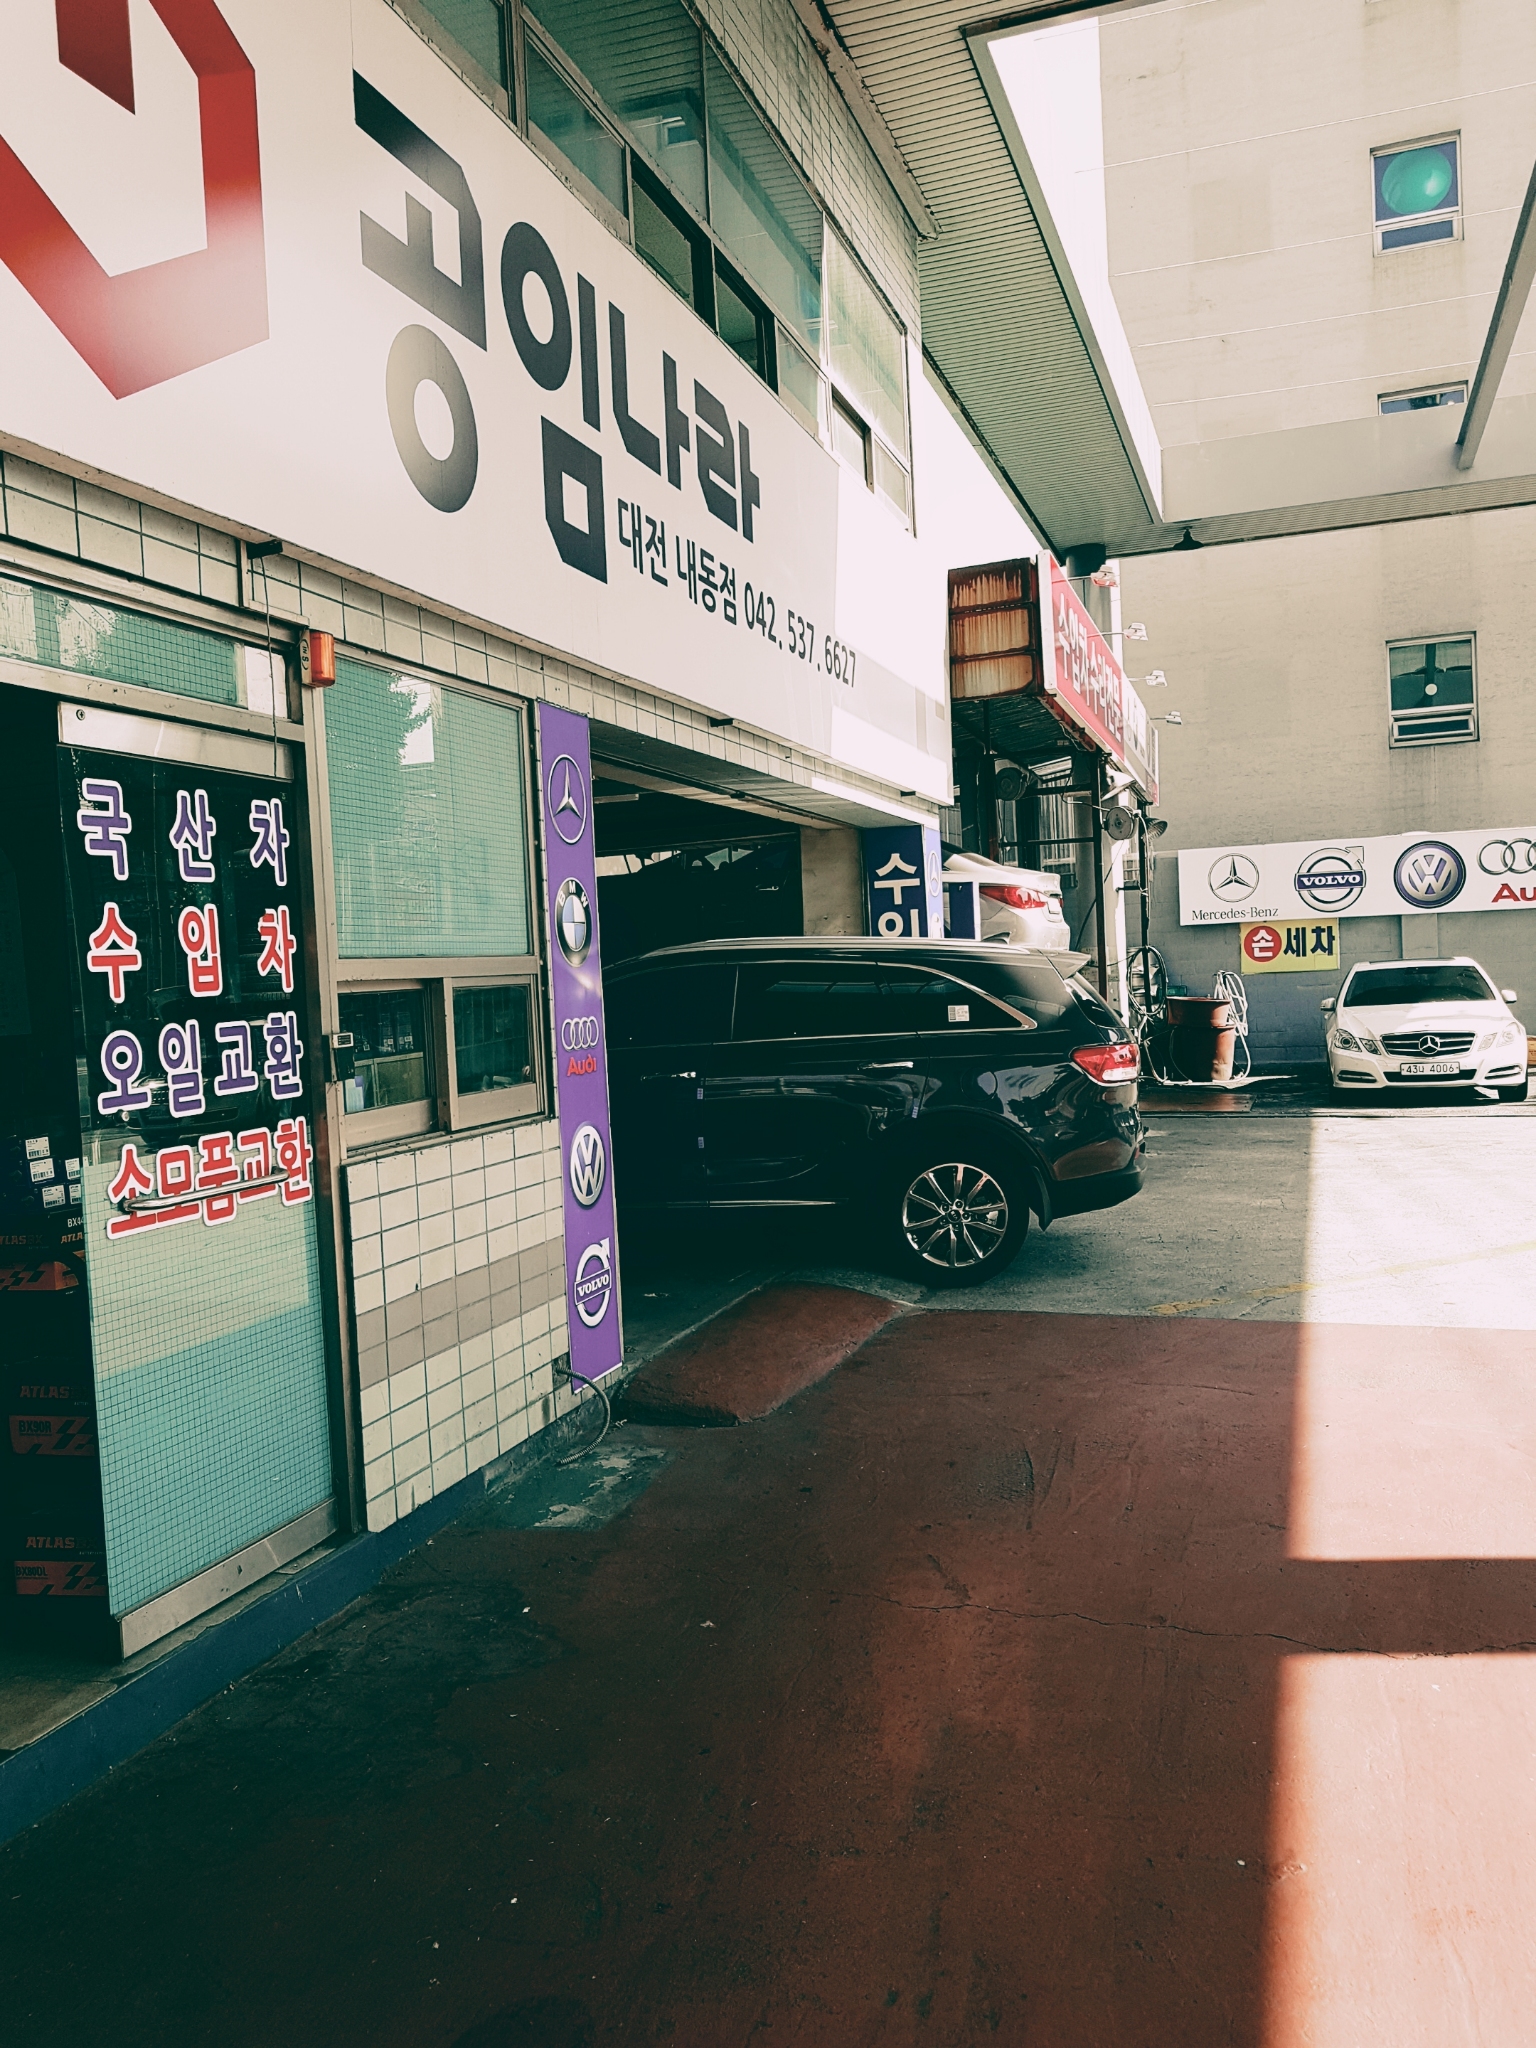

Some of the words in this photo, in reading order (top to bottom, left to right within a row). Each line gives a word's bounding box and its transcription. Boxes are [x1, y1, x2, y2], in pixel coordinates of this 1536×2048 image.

[353, 68, 761, 585] 공임나라
[617, 498, 668, 587] 대전
[676, 535, 738, 626] 내동점
[1300, 873, 1361, 887] VOLVO
[558, 881, 589, 908] BMW
[1191, 906, 1279, 922] Mercedes-Benz
[1251, 925, 1336, 959] 손세차
[98, 1011, 304, 1119] 오일교환
[566, 1056, 598, 1077] Audi
[106, 1116, 314, 1241] 소모품교환
[60, 1232, 84, 1245] ATLA
[577, 1273, 610, 1297] VOLVO
[18, 1420, 52, 1433] BX90R
